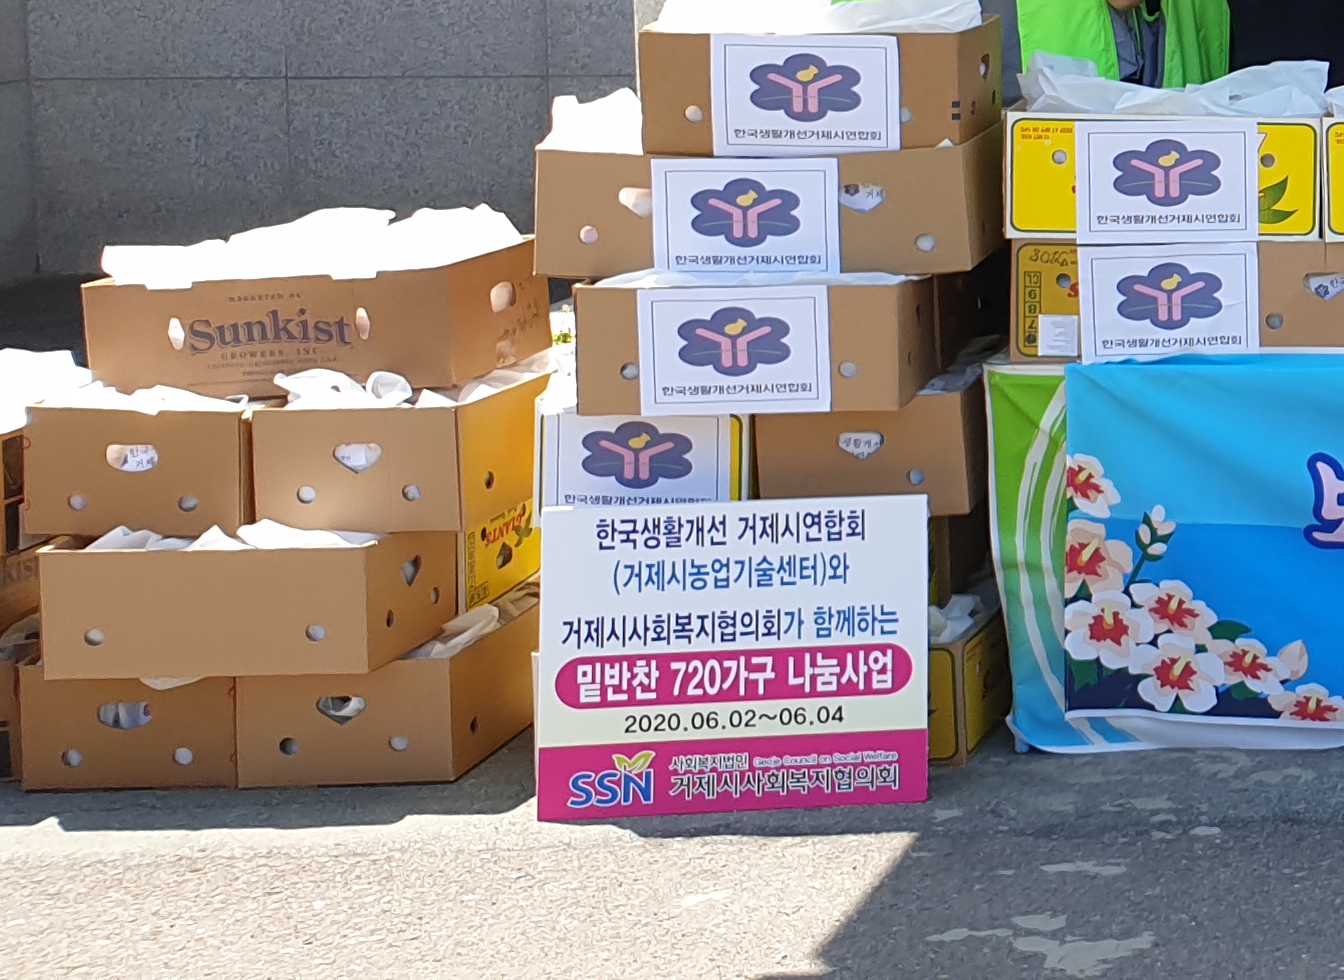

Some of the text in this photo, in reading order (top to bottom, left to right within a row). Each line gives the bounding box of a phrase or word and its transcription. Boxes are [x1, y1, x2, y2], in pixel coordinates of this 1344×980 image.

[734, 127, 882, 142] 한국생활개선거제시연합회
[1096, 211, 1241, 226] 한국생활개선거제시연합회
[675, 252, 822, 267] 한국생활개선거제시연합회
[188, 307, 353, 357] Sunkist
[1101, 333, 1243, 349] 한국생활개선거제시연합회
[661, 381, 813, 398] 한국생활개선거제시연합회
[596, 508, 867, 551] 한국생활개선 거제시연합회
[612, 551, 850, 595] (거제시농업기술센터)와
[562, 604, 900, 650] 거제시사회복지협의회가 함께하는
[576, 649, 894, 703] 밑반찬 720가구 나눔사업
[669, 752, 749, 772] 사회복지법인
[567, 765, 655, 809] SSN
[669, 763, 900, 800] 거제시사회복지협의회
